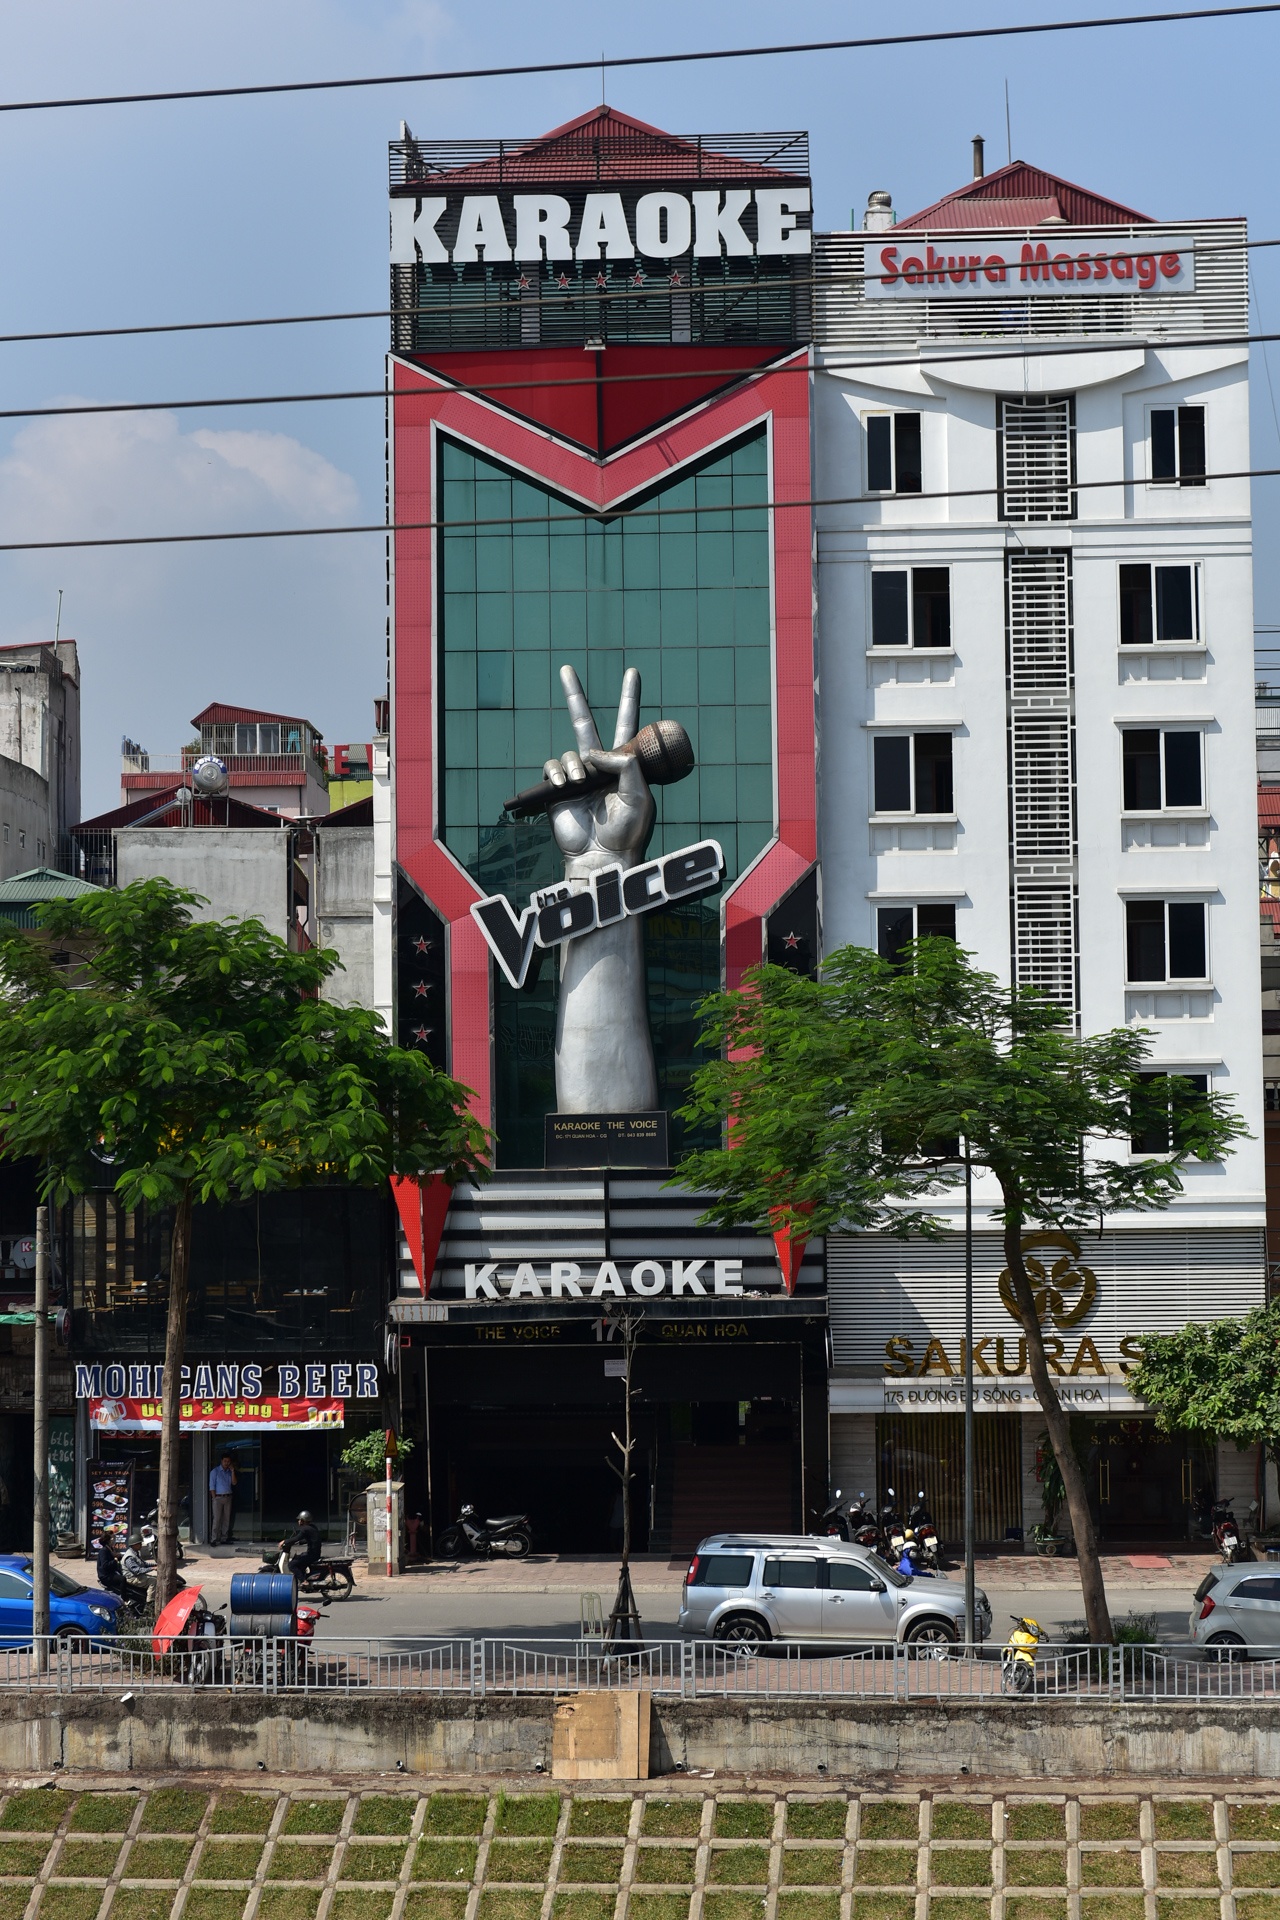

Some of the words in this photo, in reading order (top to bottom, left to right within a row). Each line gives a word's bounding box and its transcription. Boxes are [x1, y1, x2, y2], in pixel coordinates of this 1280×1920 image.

[389, 187, 812, 264] KARAOKE
[880, 246, 1006, 285] Sakura
[1019, 243, 1182, 289] Massage
[554, 1122, 601, 1131] KARAOKE
[607, 1121, 625, 1130] THE
[629, 1120, 658, 1129] VOICE
[464, 1259, 744, 1299] KARAOKE
[474, 1325, 506, 1340] THE
[512, 1325, 561, 1340] VOICE
[661, 1324, 708, 1339] QUAN
[713, 1323, 749, 1337] HOA
[883, 1336, 1107, 1377] SAKURA
[75, 1363, 263, 1399] MOHICANS
[277, 1362, 379, 1399] BEER
[884, 1390, 904, 1403] 175
[982, 1386, 1021, 1402] SÔNG
[1074, 1388, 1103, 1402] HOA
[201, 1401, 214, 1415] 3
[222, 1401, 273, 1418] Tặng
[281, 1403, 290, 1418] 1
